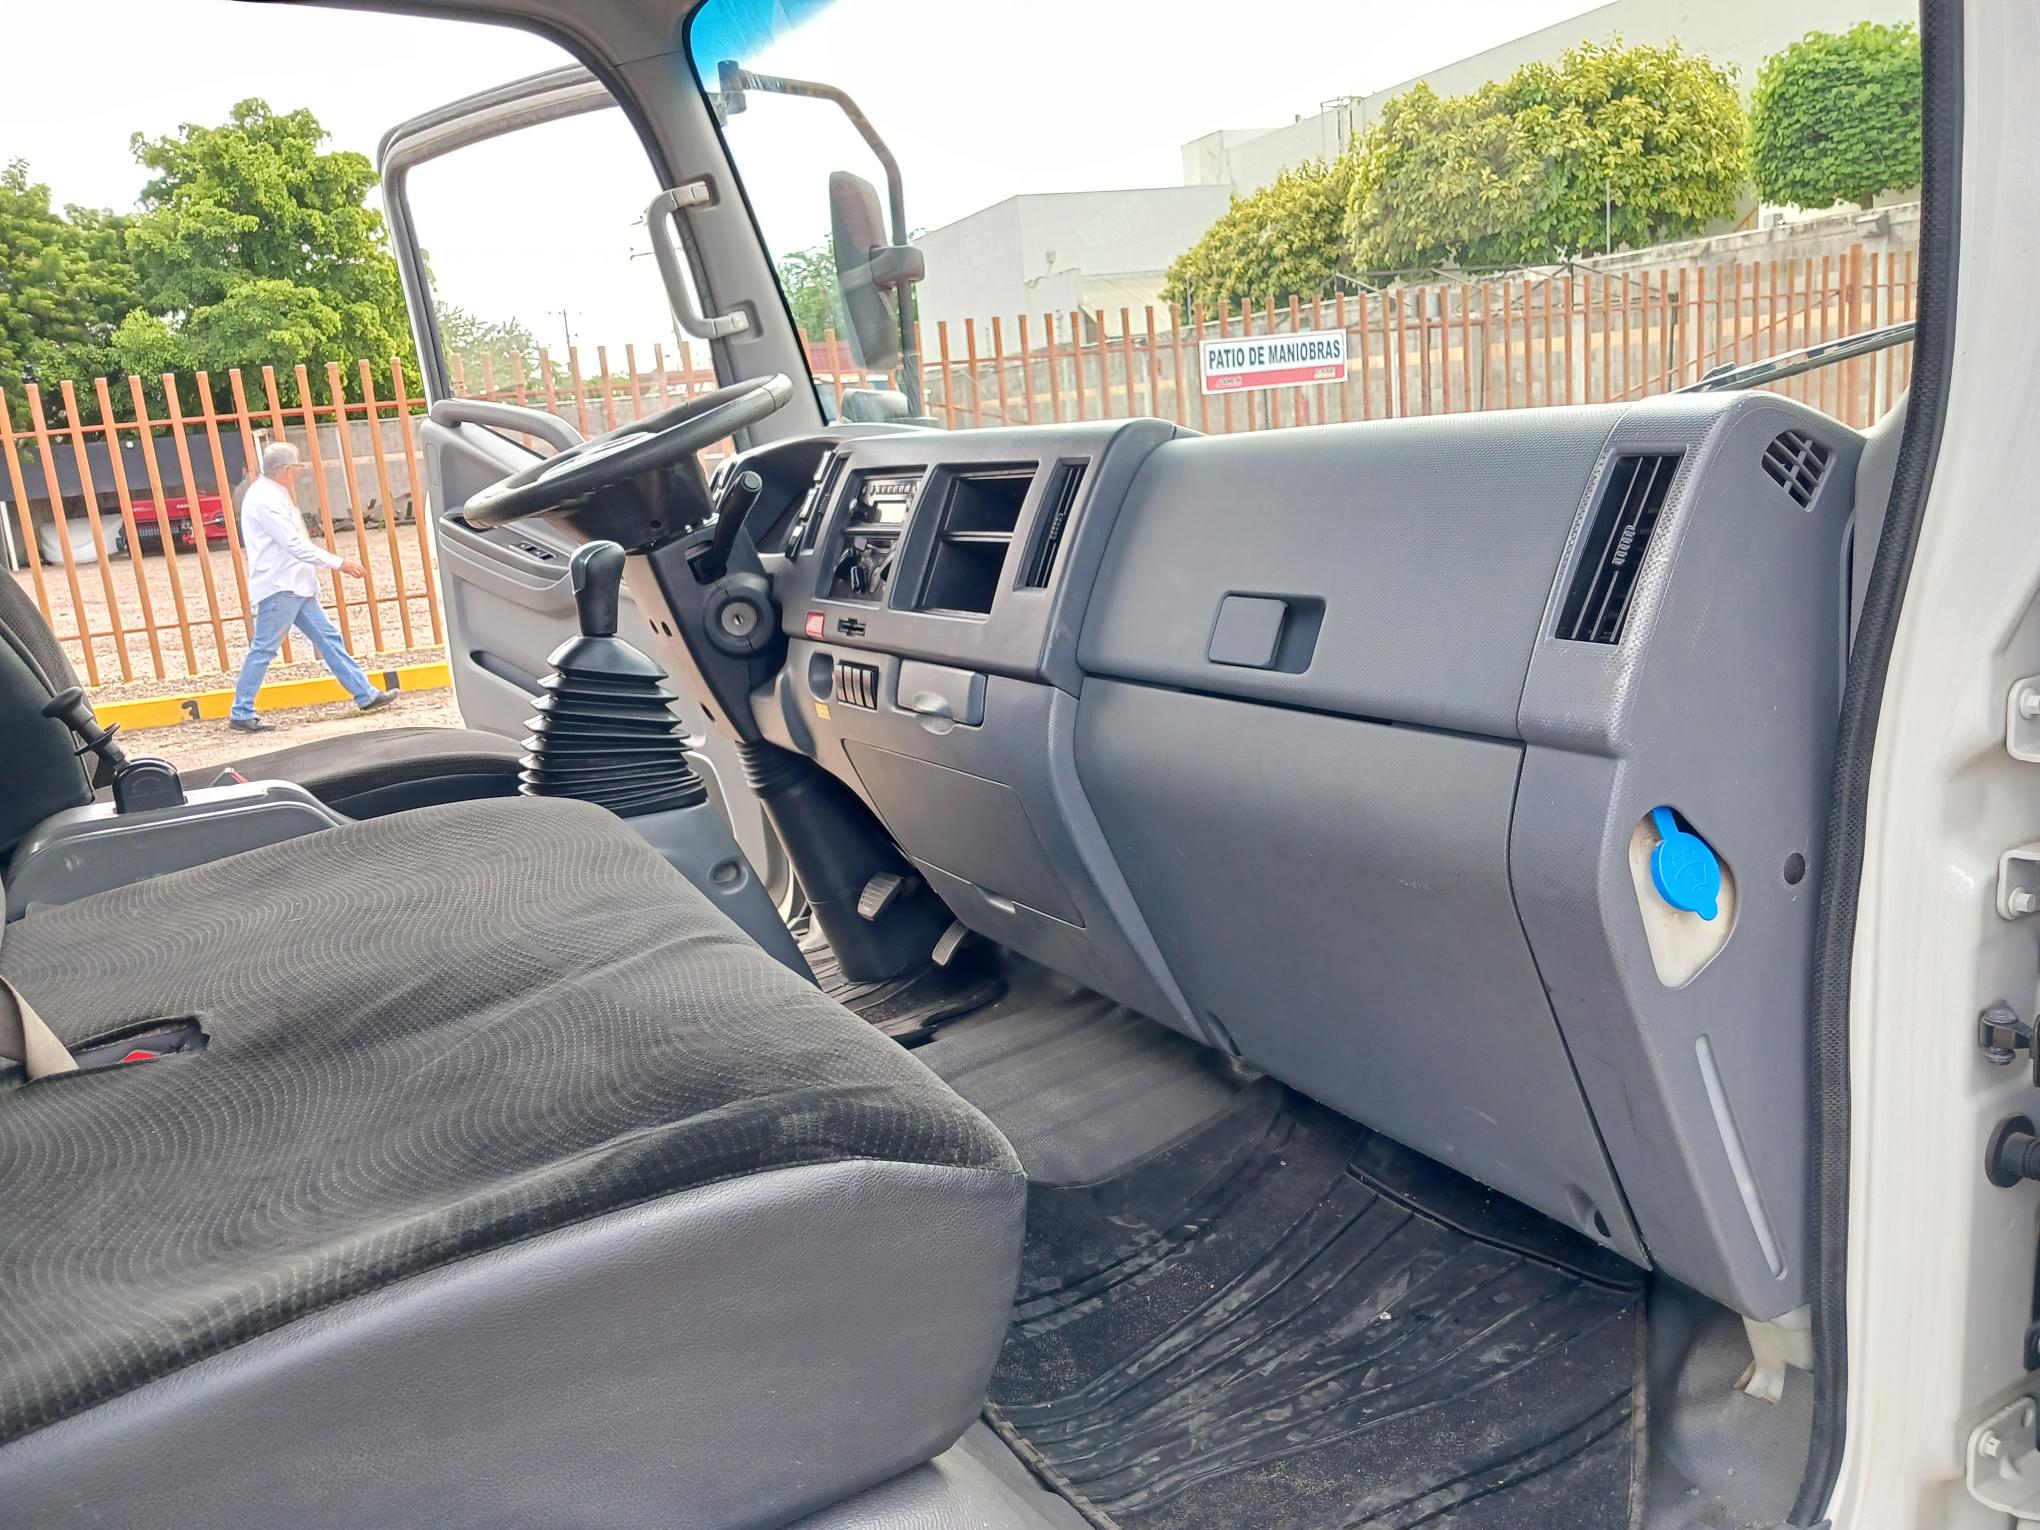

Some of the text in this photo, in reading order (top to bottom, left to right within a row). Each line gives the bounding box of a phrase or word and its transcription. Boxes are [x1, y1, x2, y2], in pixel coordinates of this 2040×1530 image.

[1209, 339, 1341, 370] PATIO DE MANIOBRAS
